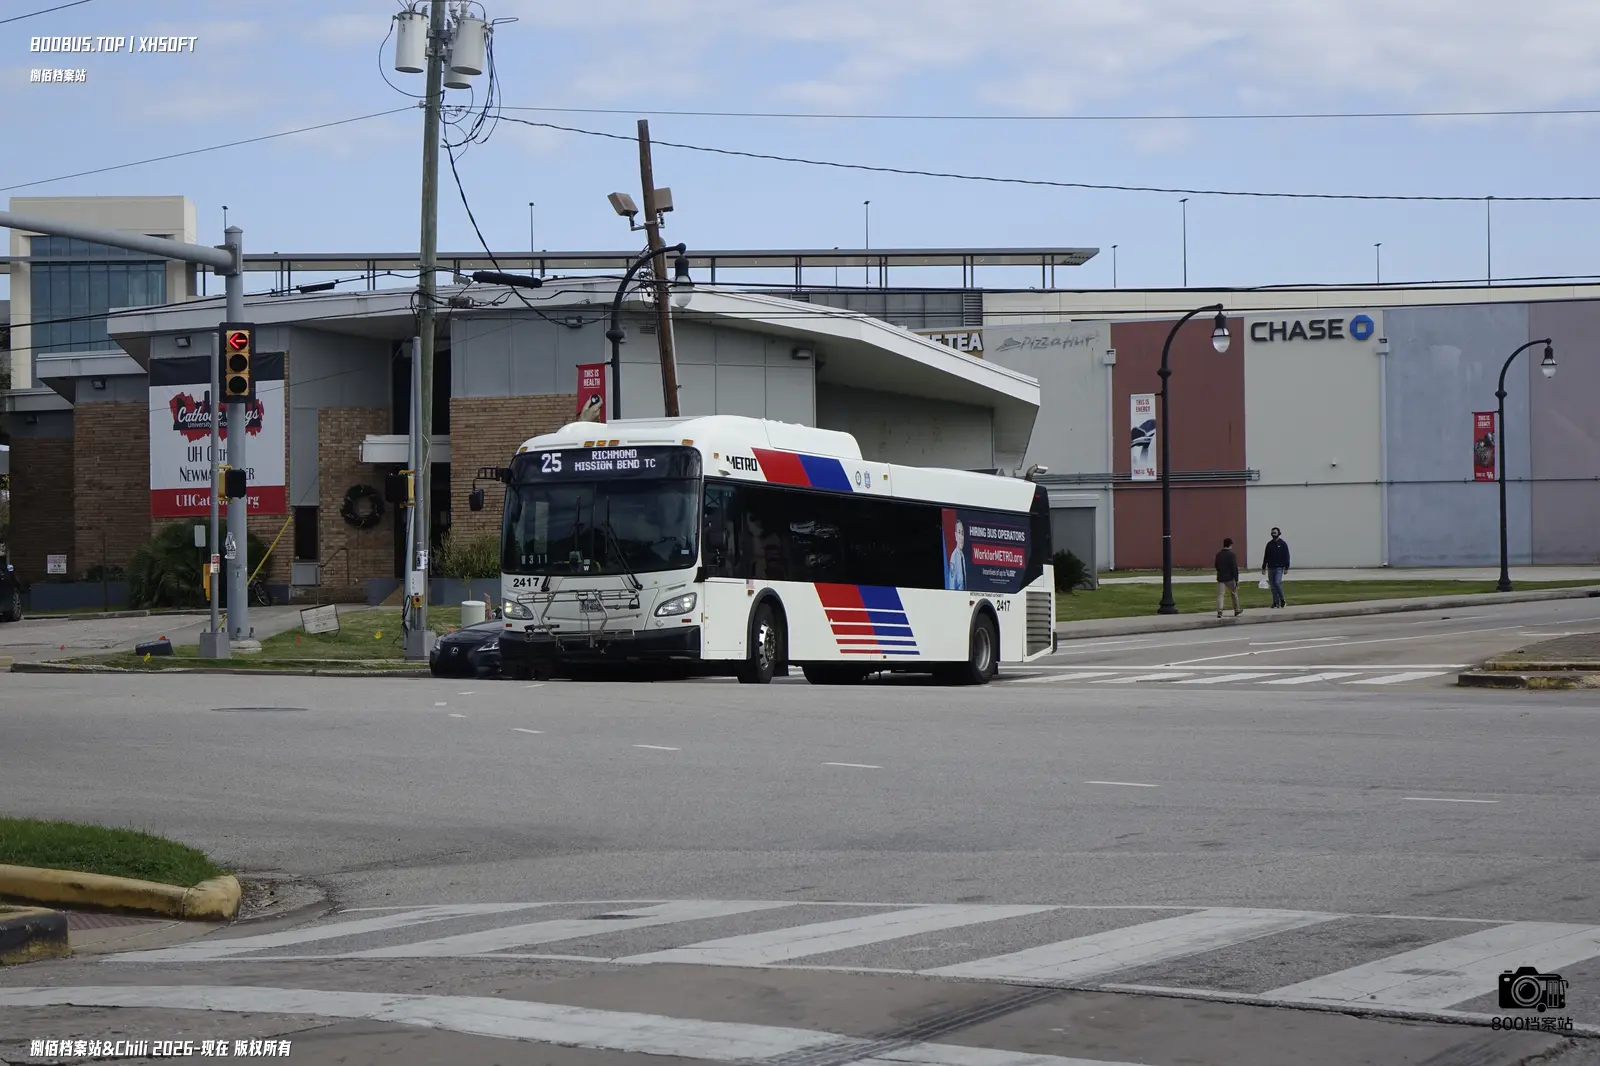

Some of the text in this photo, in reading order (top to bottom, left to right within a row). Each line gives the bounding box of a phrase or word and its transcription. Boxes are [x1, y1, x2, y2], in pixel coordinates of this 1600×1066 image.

[1250, 318, 1345, 342] CHASE
[584, 369, 600, 377] THIS IS
[583, 378, 600, 387] HEALTH
[177, 406, 223, 423] Cathoc
[187, 446, 203, 463] UH
[592, 449, 638, 460] RICHMOND
[541, 453, 562, 473] 25
[575, 458, 656, 471] MISSION BEND TC
[726, 455, 758, 472] METRO
[969, 526, 1026, 542] HIRING BUS OPERATORS
[973, 547, 1023, 566] WorkforMETRO.org
[513, 577, 540, 588] 2417
[996, 600, 1011, 612] 2417
